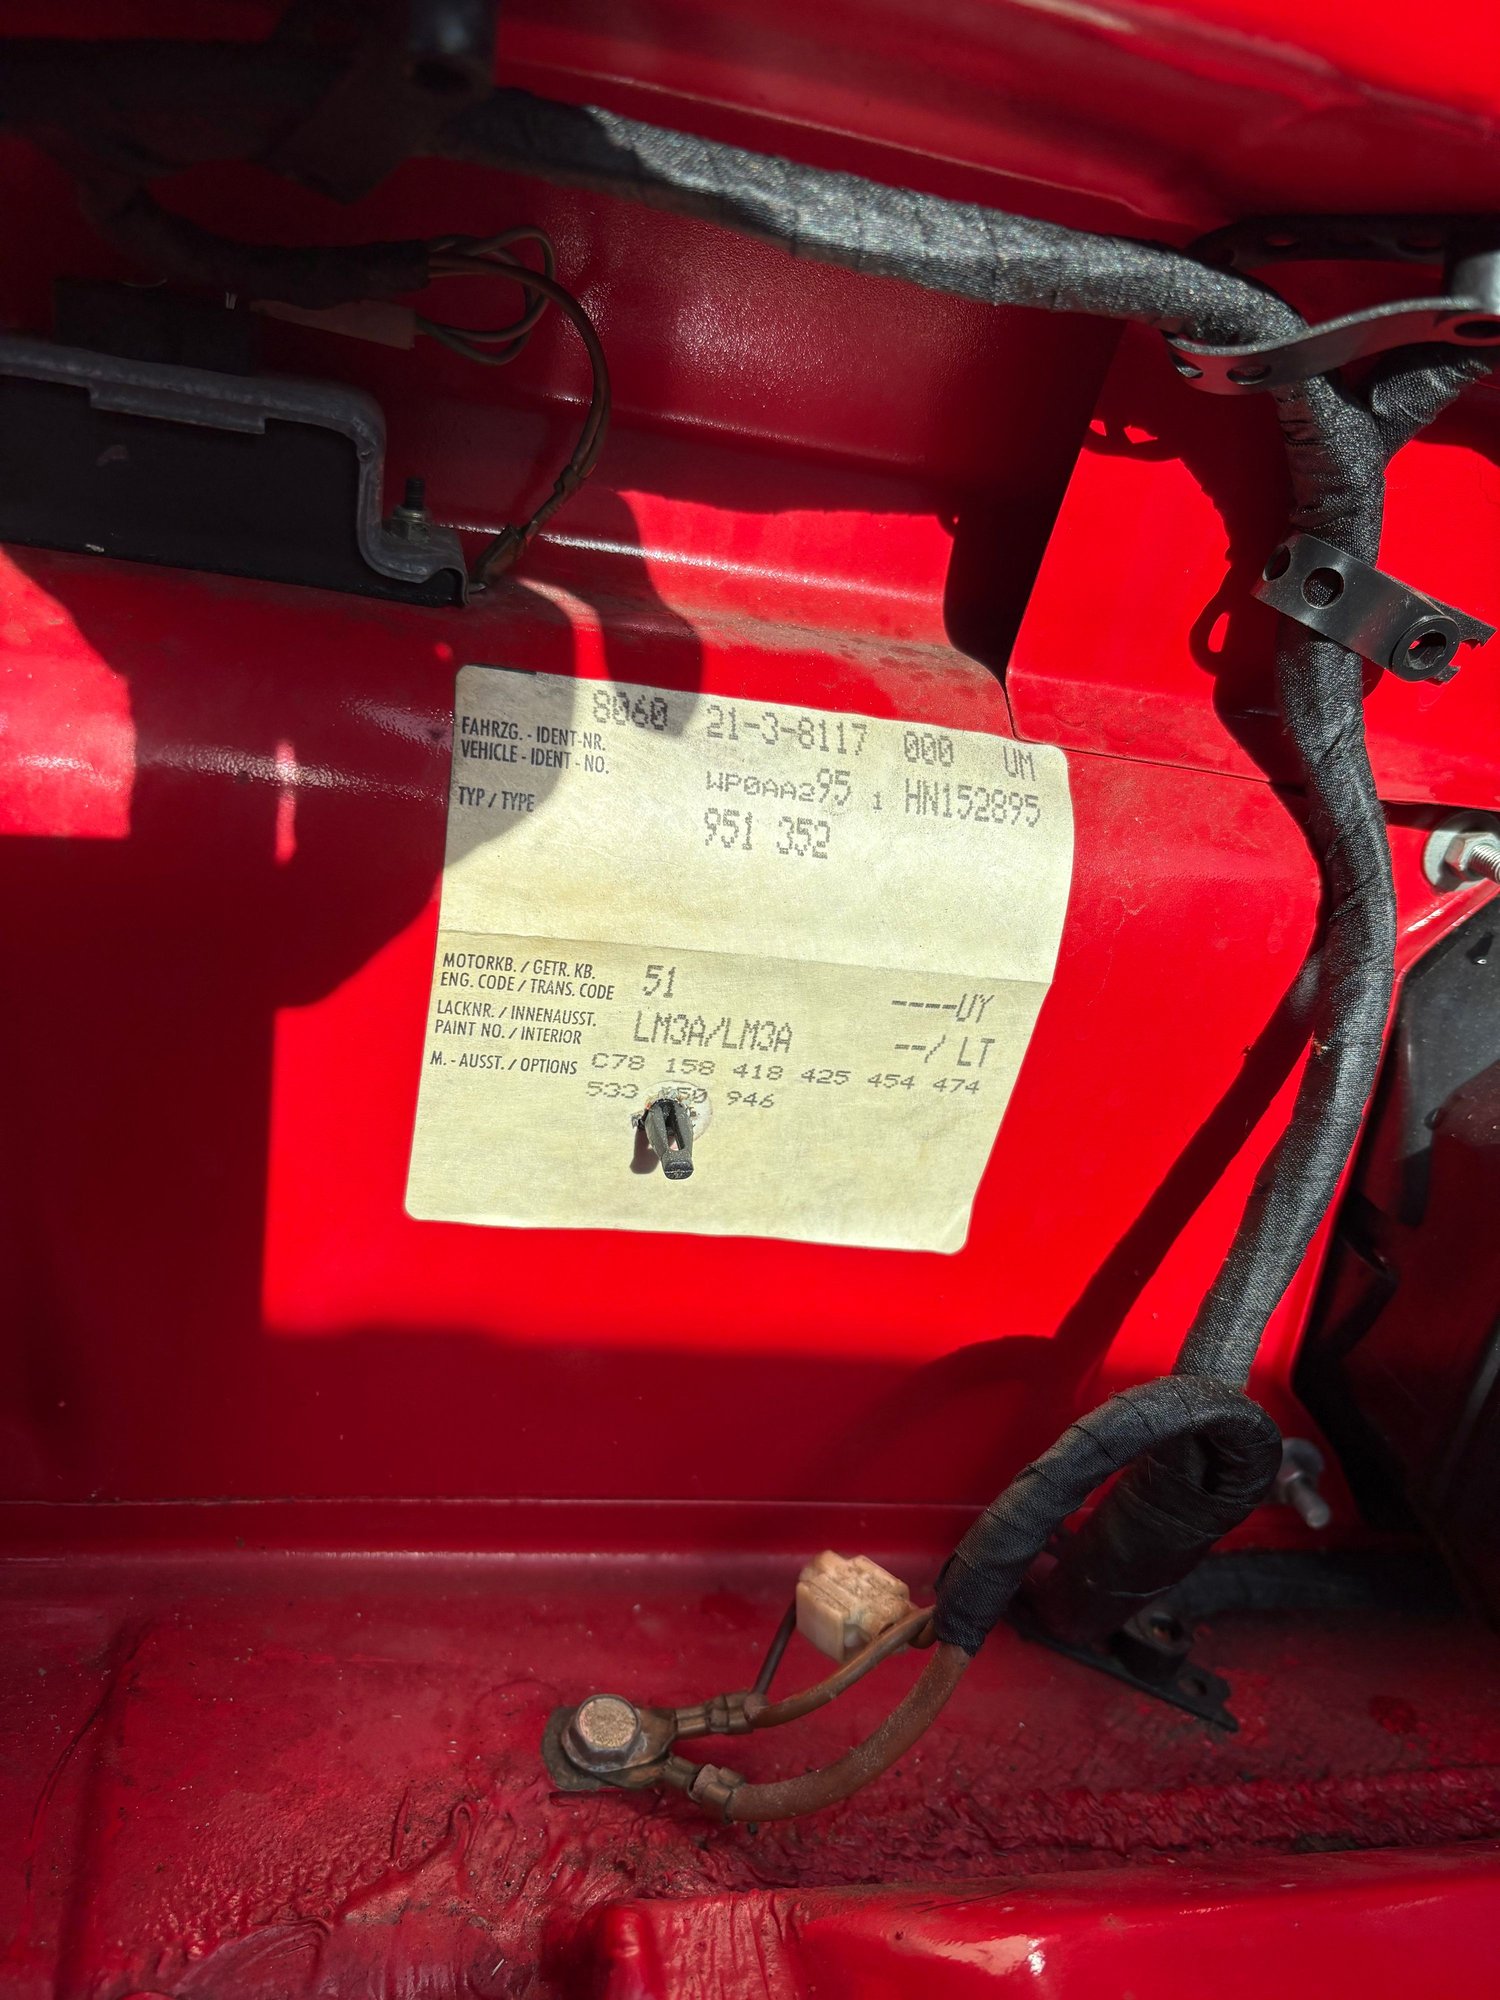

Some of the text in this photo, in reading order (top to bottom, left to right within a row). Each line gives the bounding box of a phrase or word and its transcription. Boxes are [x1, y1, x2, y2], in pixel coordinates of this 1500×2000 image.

[593, 689, 668, 731] 8060
[706, 704, 868, 756] 21-3-8117
[1003, 745, 1036, 781] UM
[905, 778, 1041, 828] HN152895
[704, 807, 831, 859] 951 352
[579, 983, 615, 1000] CODE
[643, 965, 677, 998] 51
[434, 1019, 477, 1036] PAINT
[634, 1010, 793, 1053] LM3A/LM3A
[586, 1081, 775, 1108] 533 50 946
[591, 1052, 981, 1095] C78 158 418 425 454 474
